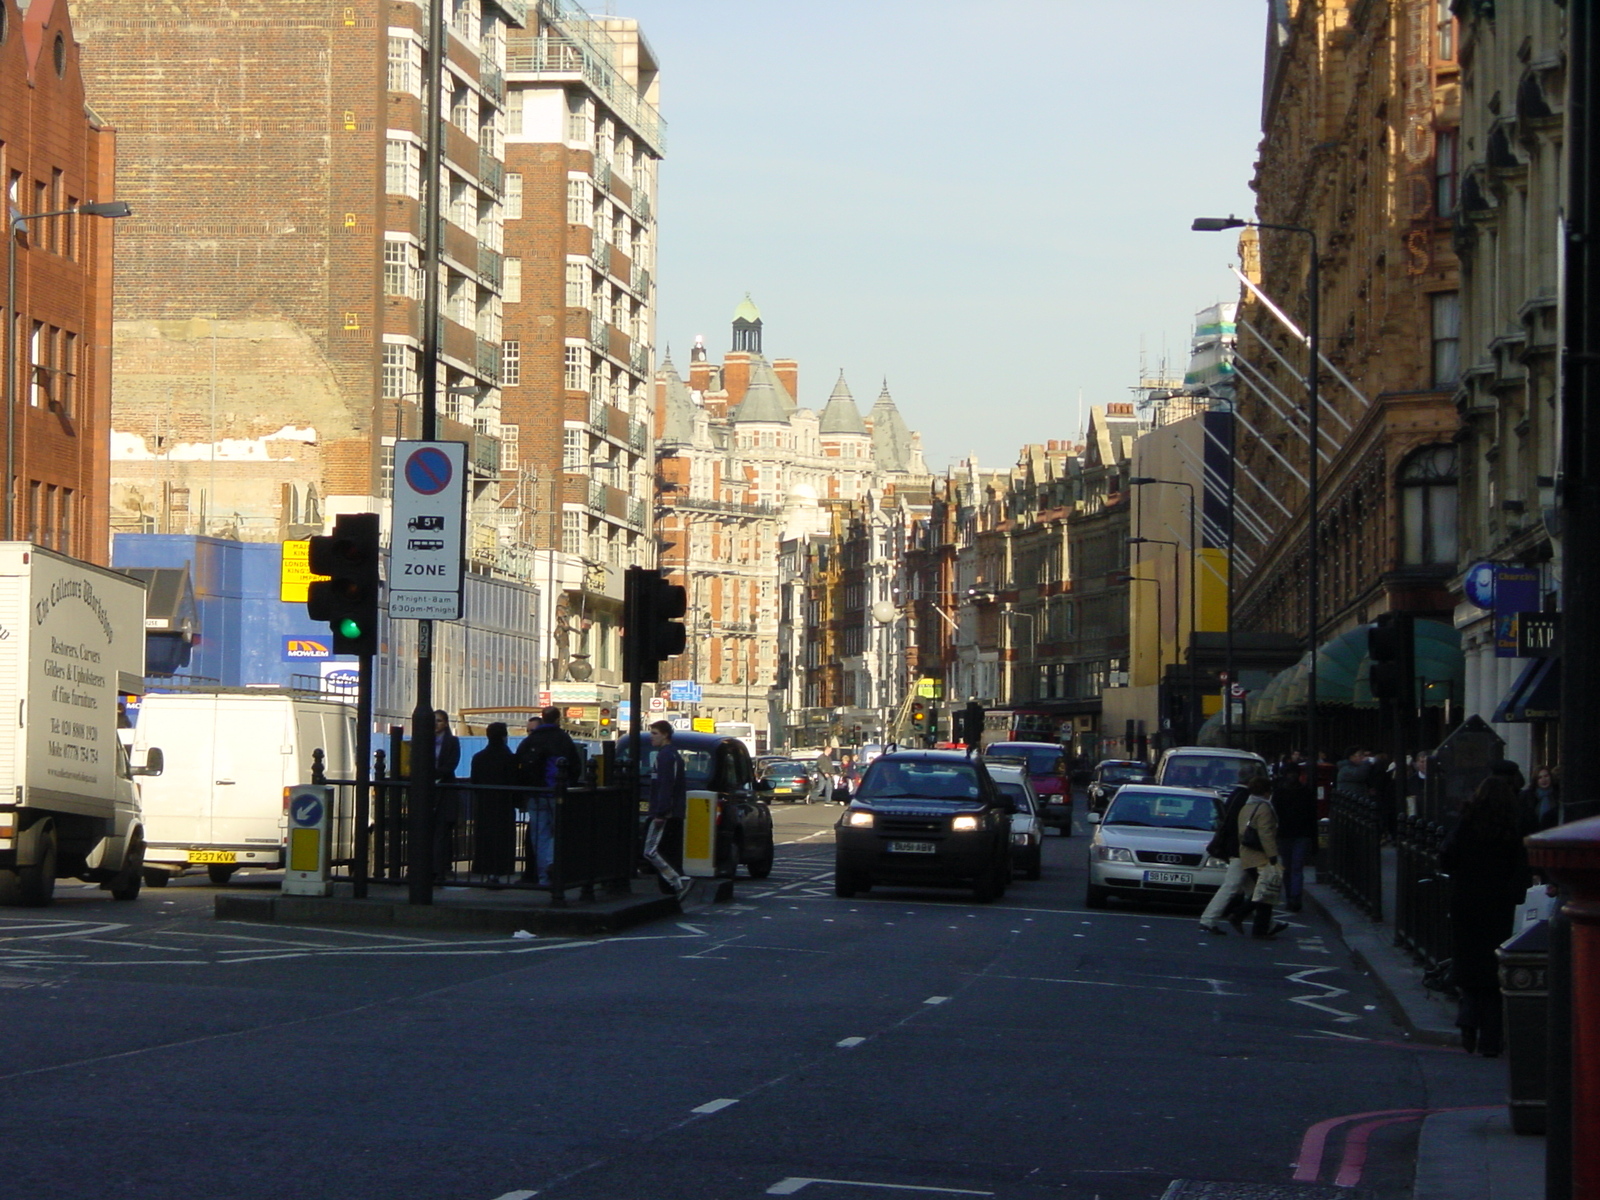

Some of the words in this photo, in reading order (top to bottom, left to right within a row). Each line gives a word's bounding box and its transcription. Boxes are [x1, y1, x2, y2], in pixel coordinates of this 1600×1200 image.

[424, 517, 437, 527] 5T
[404, 563, 447, 577] ZONE
[36, 597, 49, 626] The
[50, 577, 82, 607] Collectors
[1527, 627, 1554, 648] GAP
[287, 650, 329, 658] MOWLEM
[44, 658, 65, 680] Gilders
[66, 663, 72, 681] &
[189, 852, 215, 862] F237
[217, 852, 237, 862] KVX
